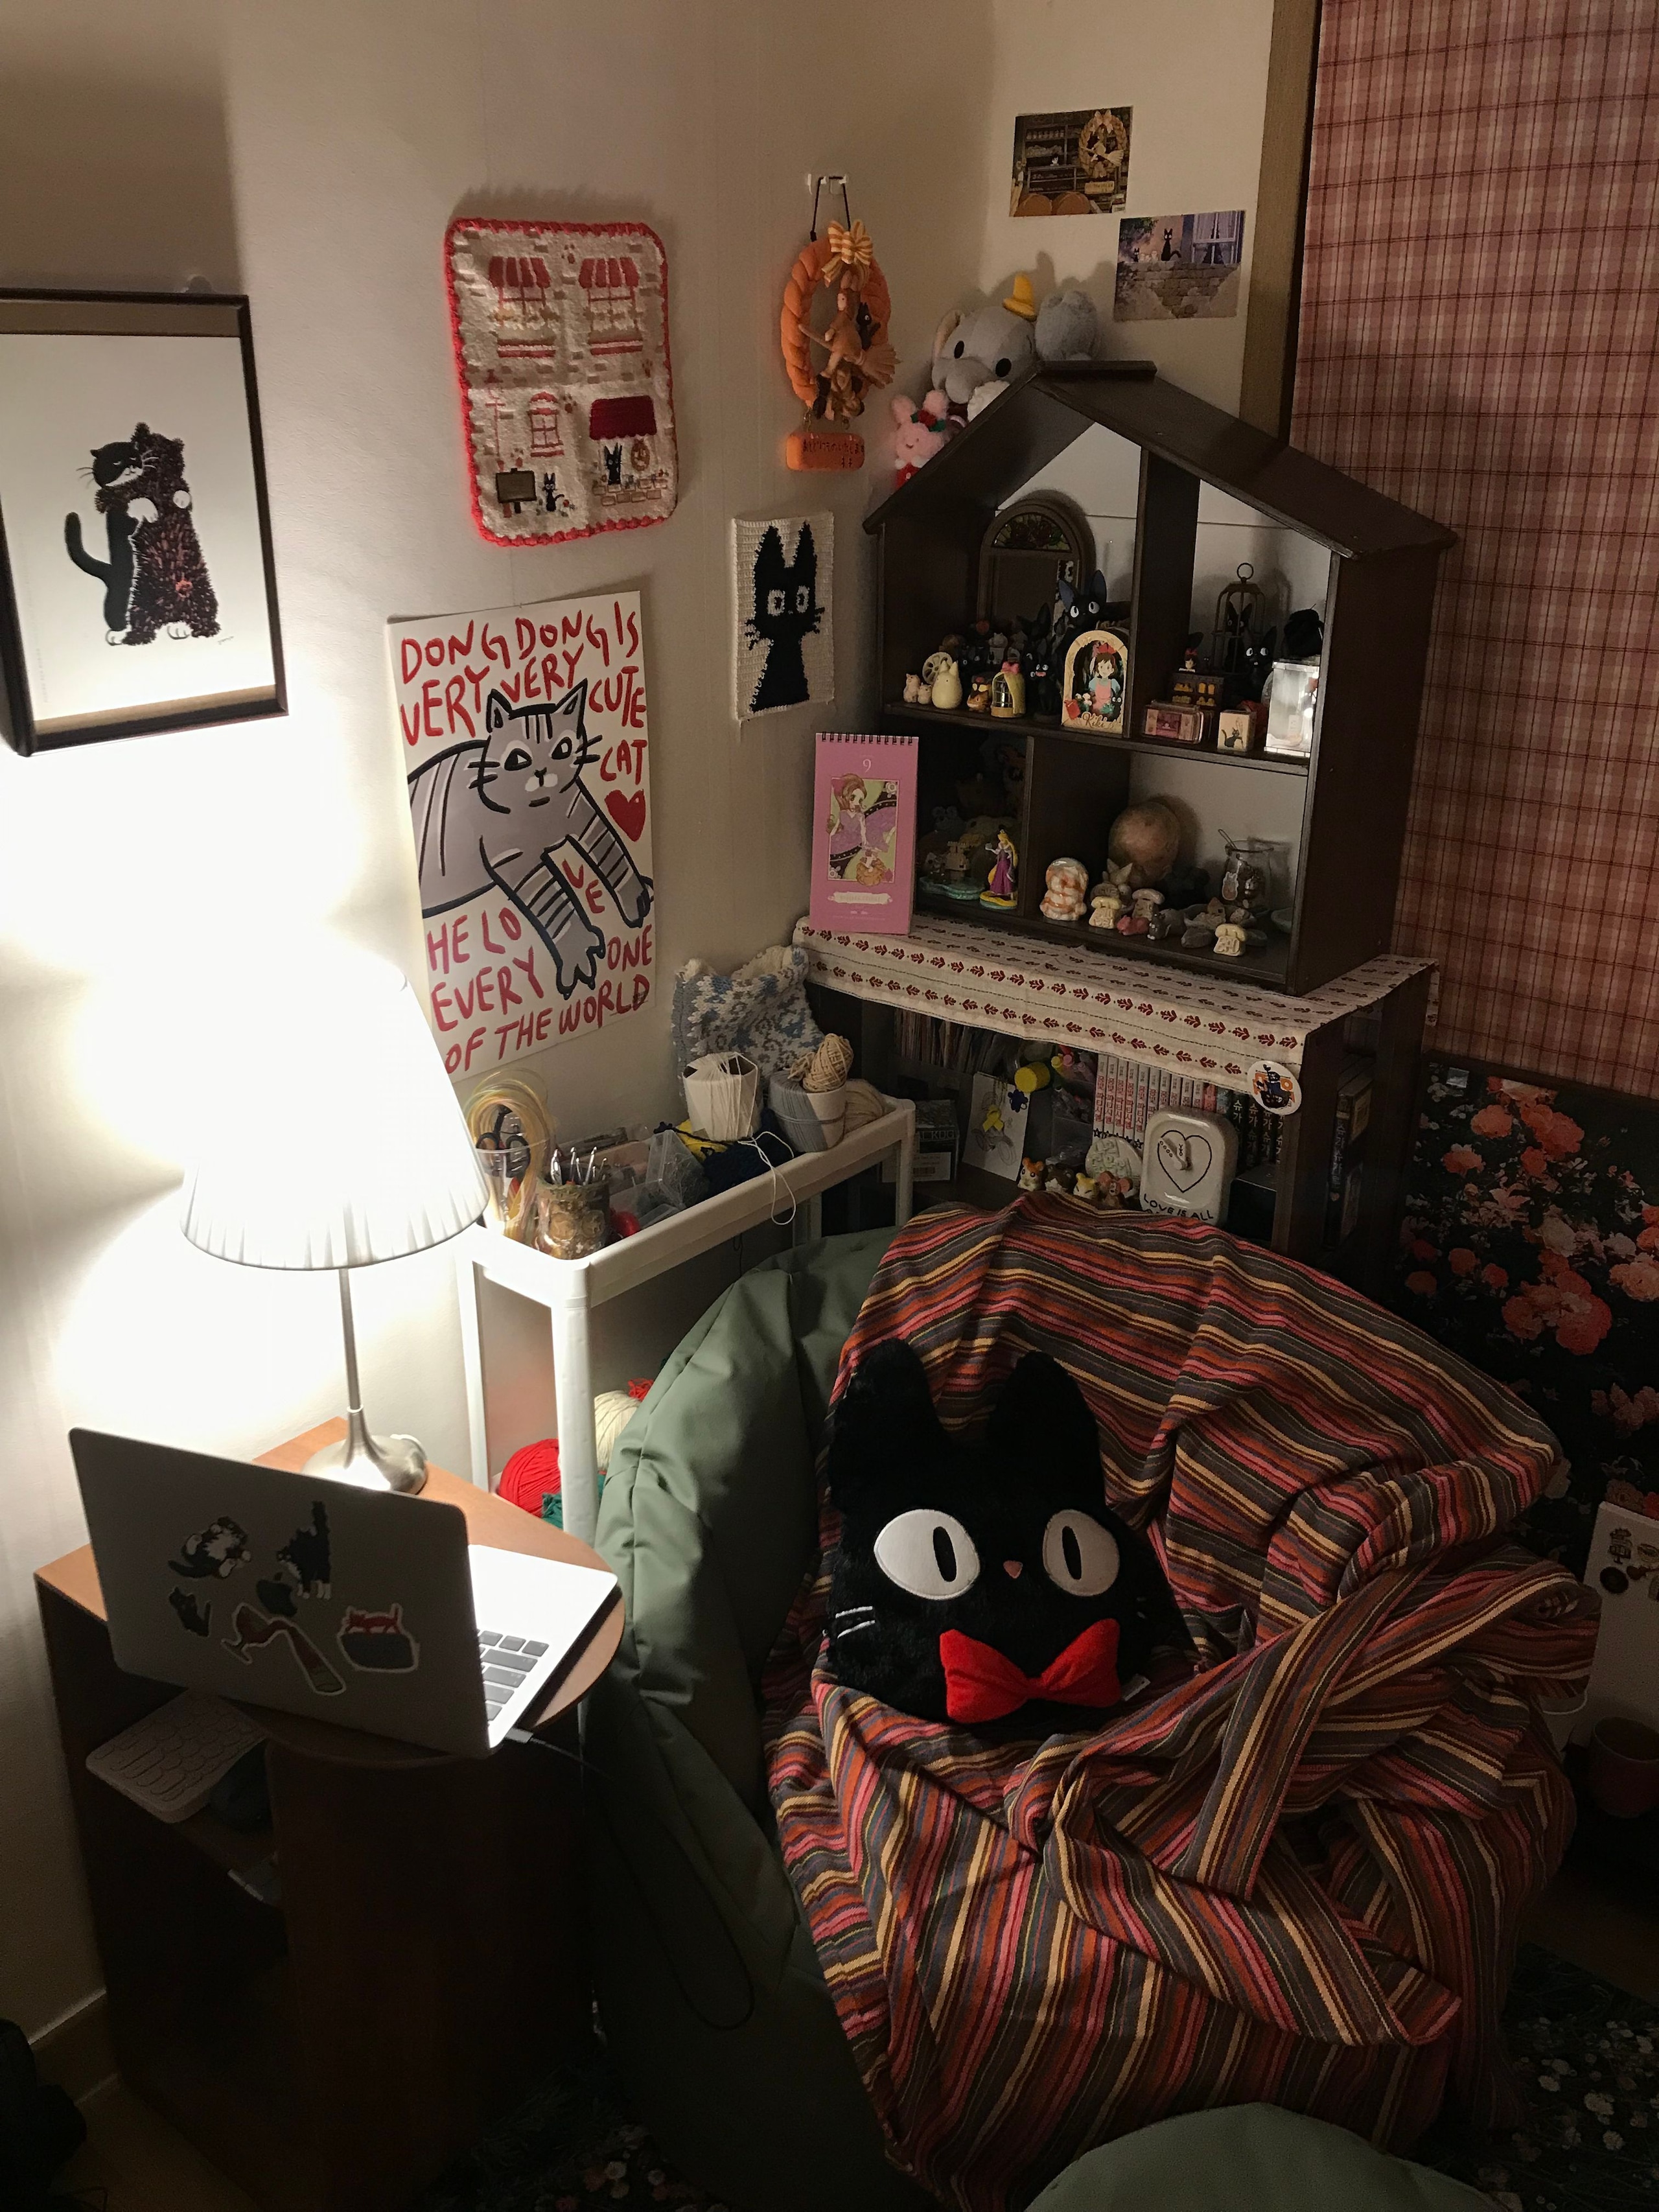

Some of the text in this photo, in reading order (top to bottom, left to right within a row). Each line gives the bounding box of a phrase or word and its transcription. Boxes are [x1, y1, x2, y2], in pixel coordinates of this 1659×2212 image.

[614, 601, 639, 658] IS
[400, 642, 647, 747] VERY VERY CUTE
[1082, 712, 1106, 728] Kiki
[600, 739, 647, 785] CAT
[863, 758, 872, 773] 9
[427, 914, 470, 974] HE
[431, 924, 653, 1032] EVERY ONE
[445, 973, 651, 1075] OF THE WORLD
[1143, 1193, 1175, 1214] LOVE
[1177, 1209, 1187, 1217] IS
[1190, 1210, 1214, 1221] ALL
